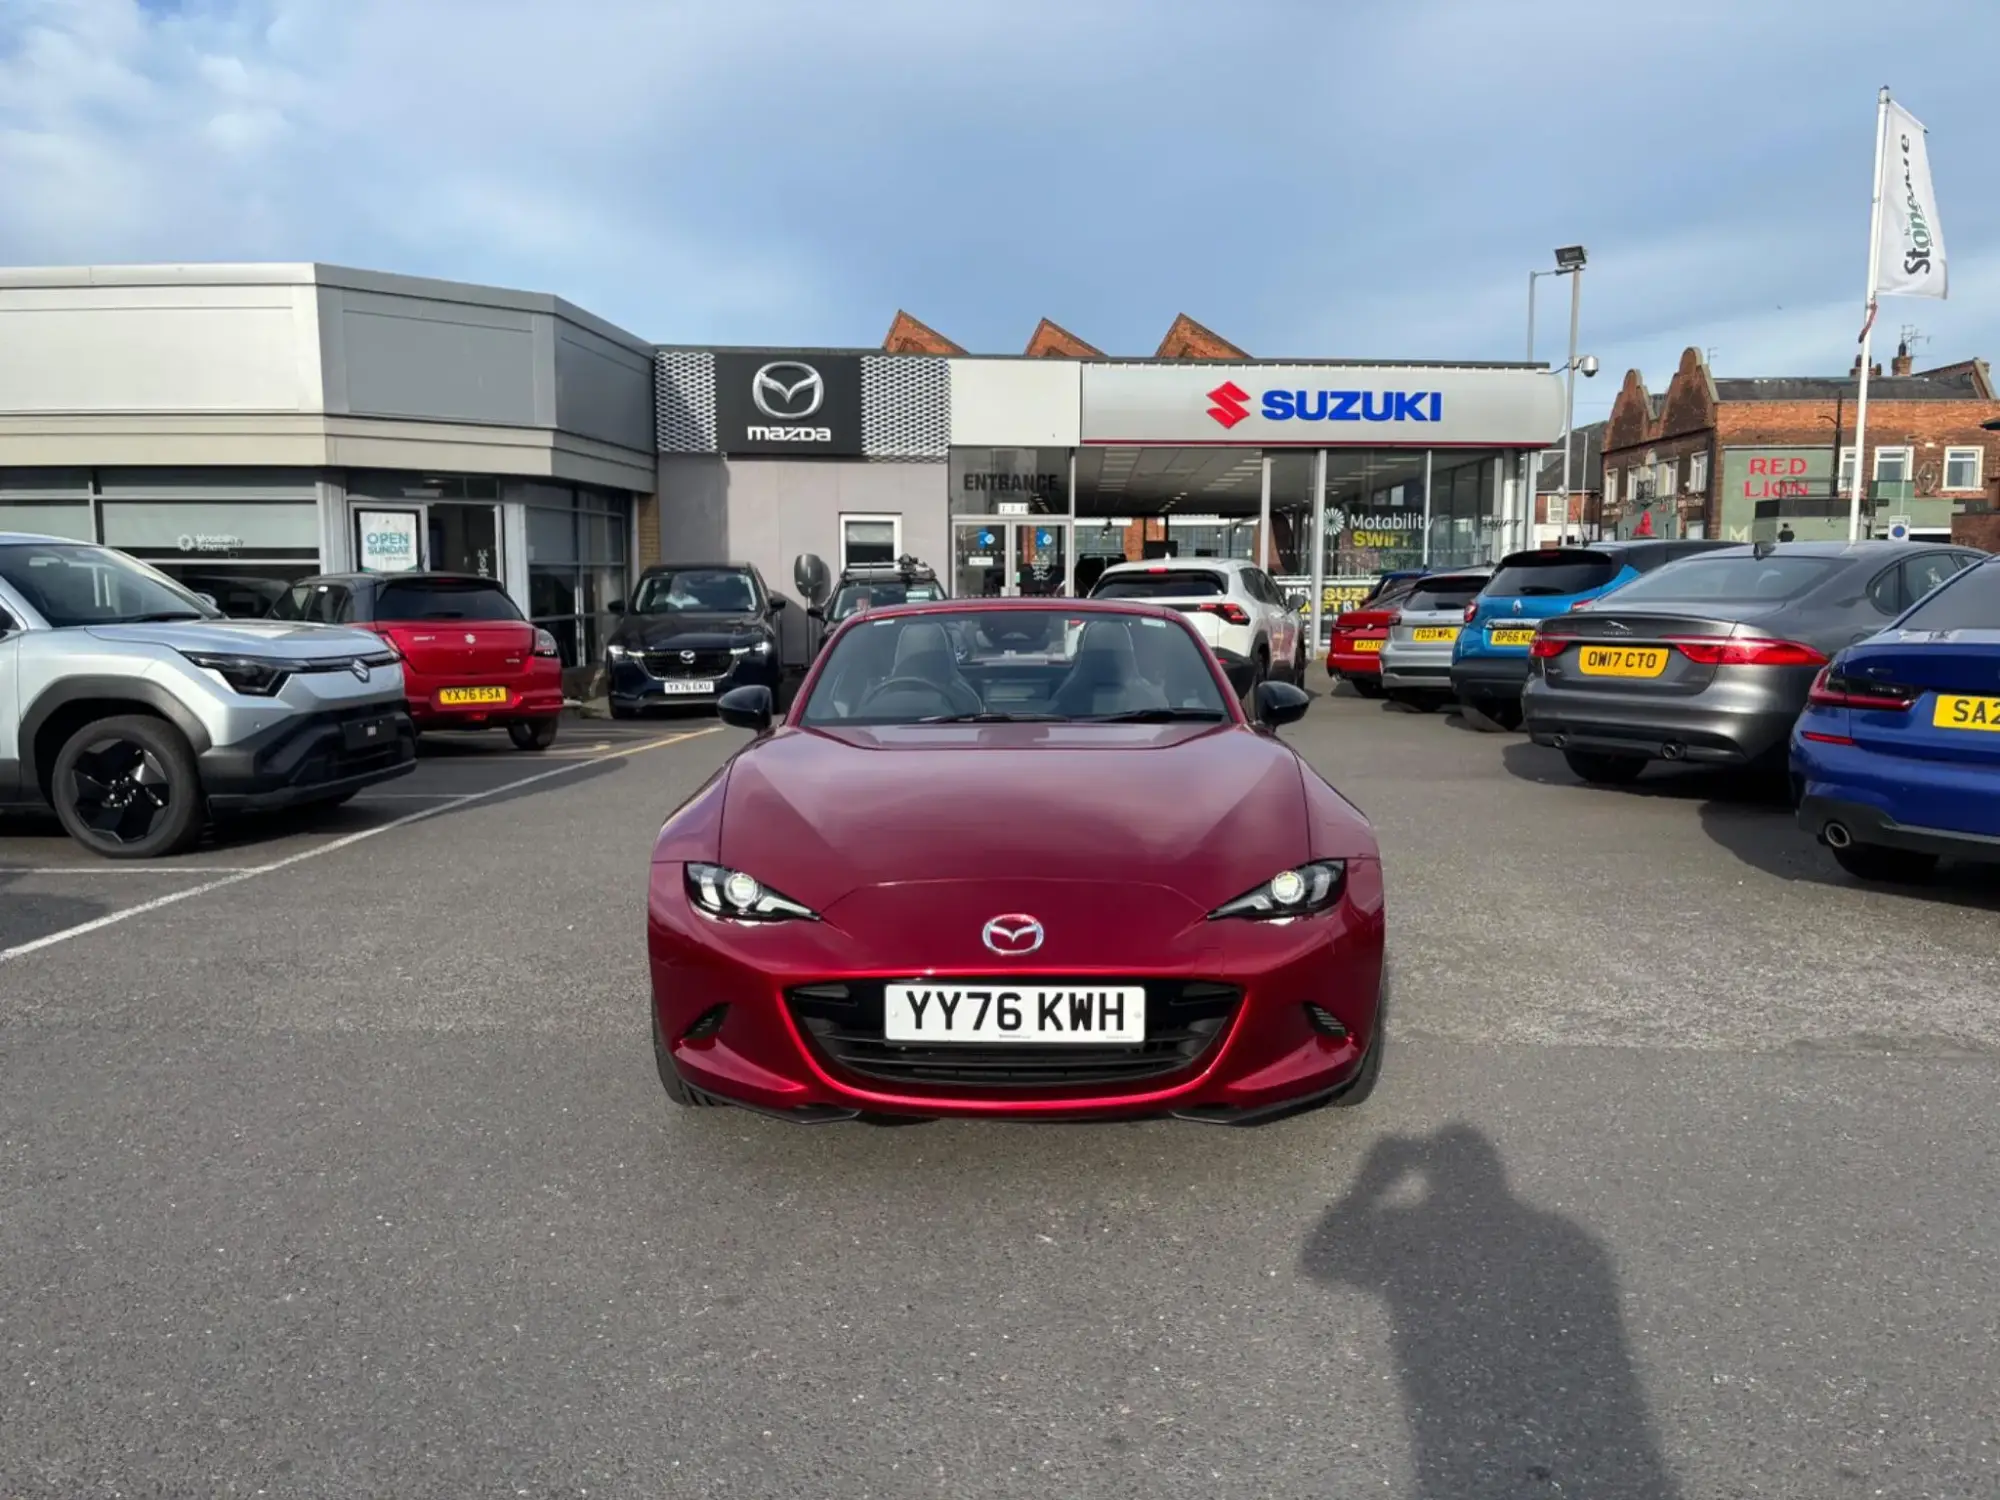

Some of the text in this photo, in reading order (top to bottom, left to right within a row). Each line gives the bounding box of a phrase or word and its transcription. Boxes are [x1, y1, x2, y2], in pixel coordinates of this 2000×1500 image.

[1261, 390, 1442, 421] SUZUKI
[747, 426, 831, 441] mazda
[1748, 457, 1807, 475] RED
[964, 473, 1059, 491] ENTRANCE
[1744, 479, 1808, 498] LION
[1350, 512, 1433, 531] Motability
[367, 532, 409, 545] OPEN
[1352, 531, 1412, 547] SWIFT
[367, 545, 409, 555] SUNDAY
[1588, 651, 1657, 669] OW17 CTO
[444, 688, 503, 701] YX76 FSA
[906, 991, 1124, 1031] YY76 KWH
